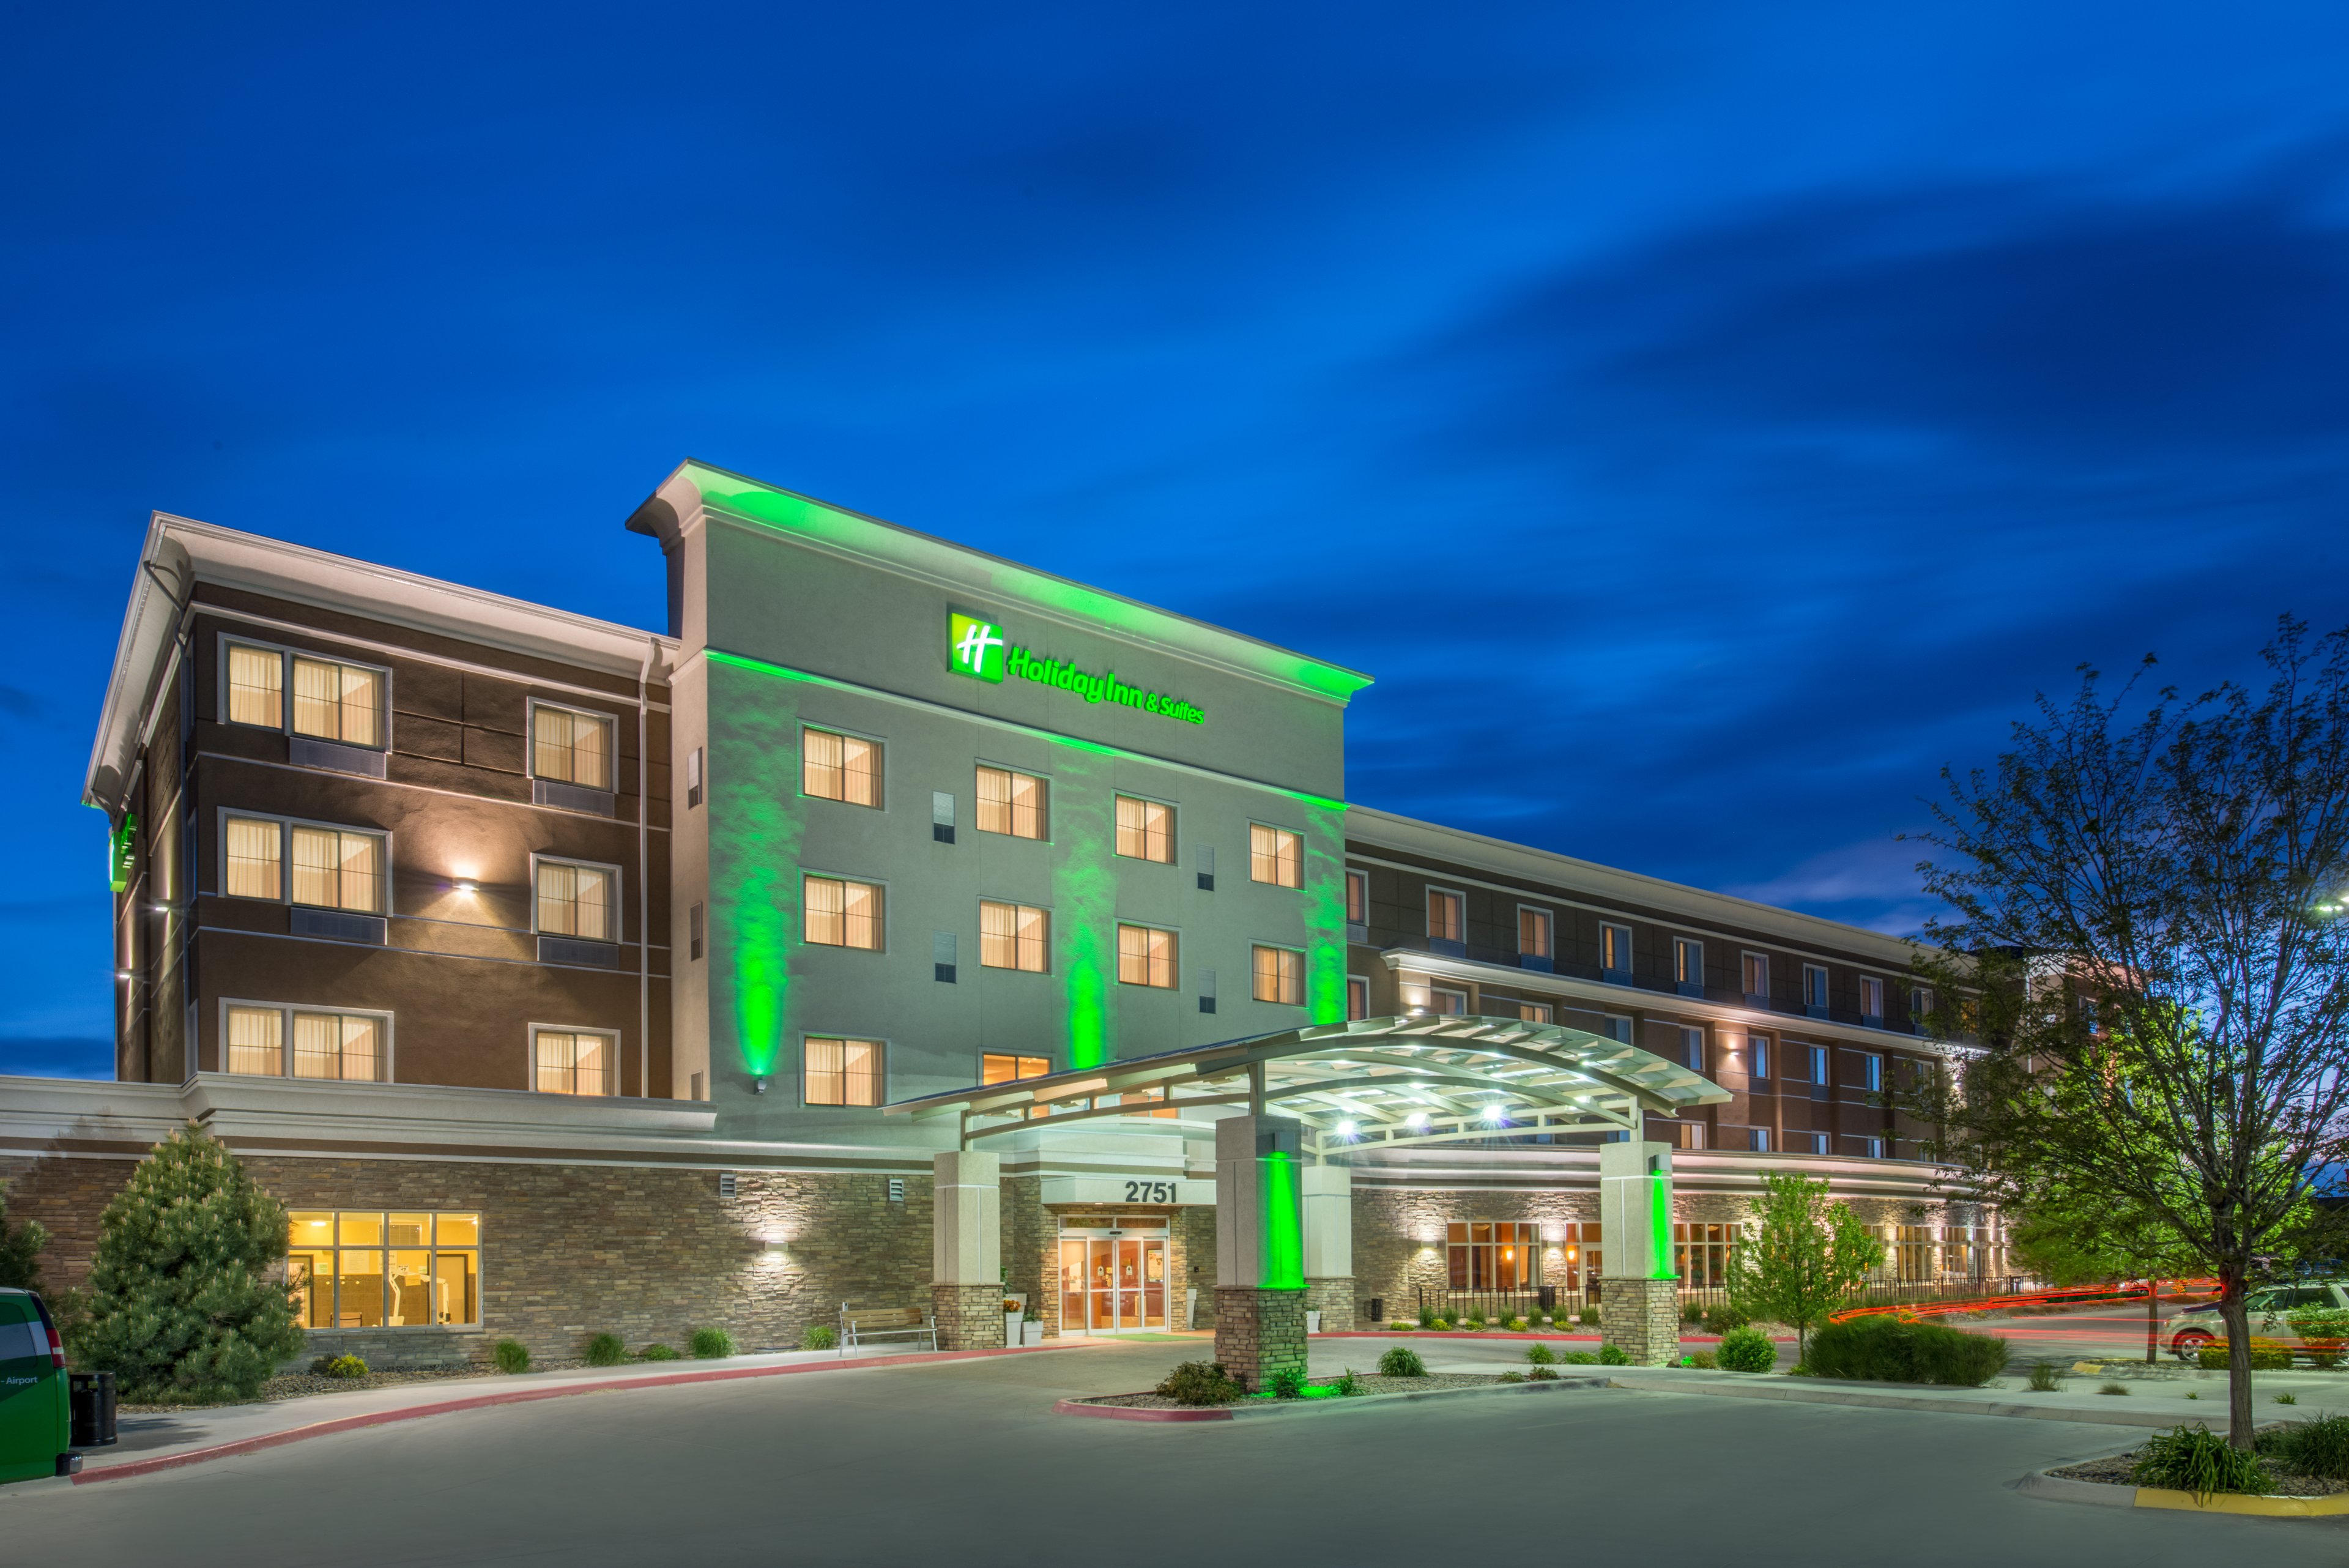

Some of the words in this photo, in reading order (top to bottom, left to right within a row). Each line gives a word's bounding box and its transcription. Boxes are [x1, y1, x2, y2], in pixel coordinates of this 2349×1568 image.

[1007, 646, 1104, 704] Holiday
[1104, 673, 1143, 708] Inn
[1145, 693, 1159, 713] &
[1160, 696, 1205, 724] Suites
[1125, 1181, 1177, 1203] 2751
[6, 1377, 38, 1386] Airport
